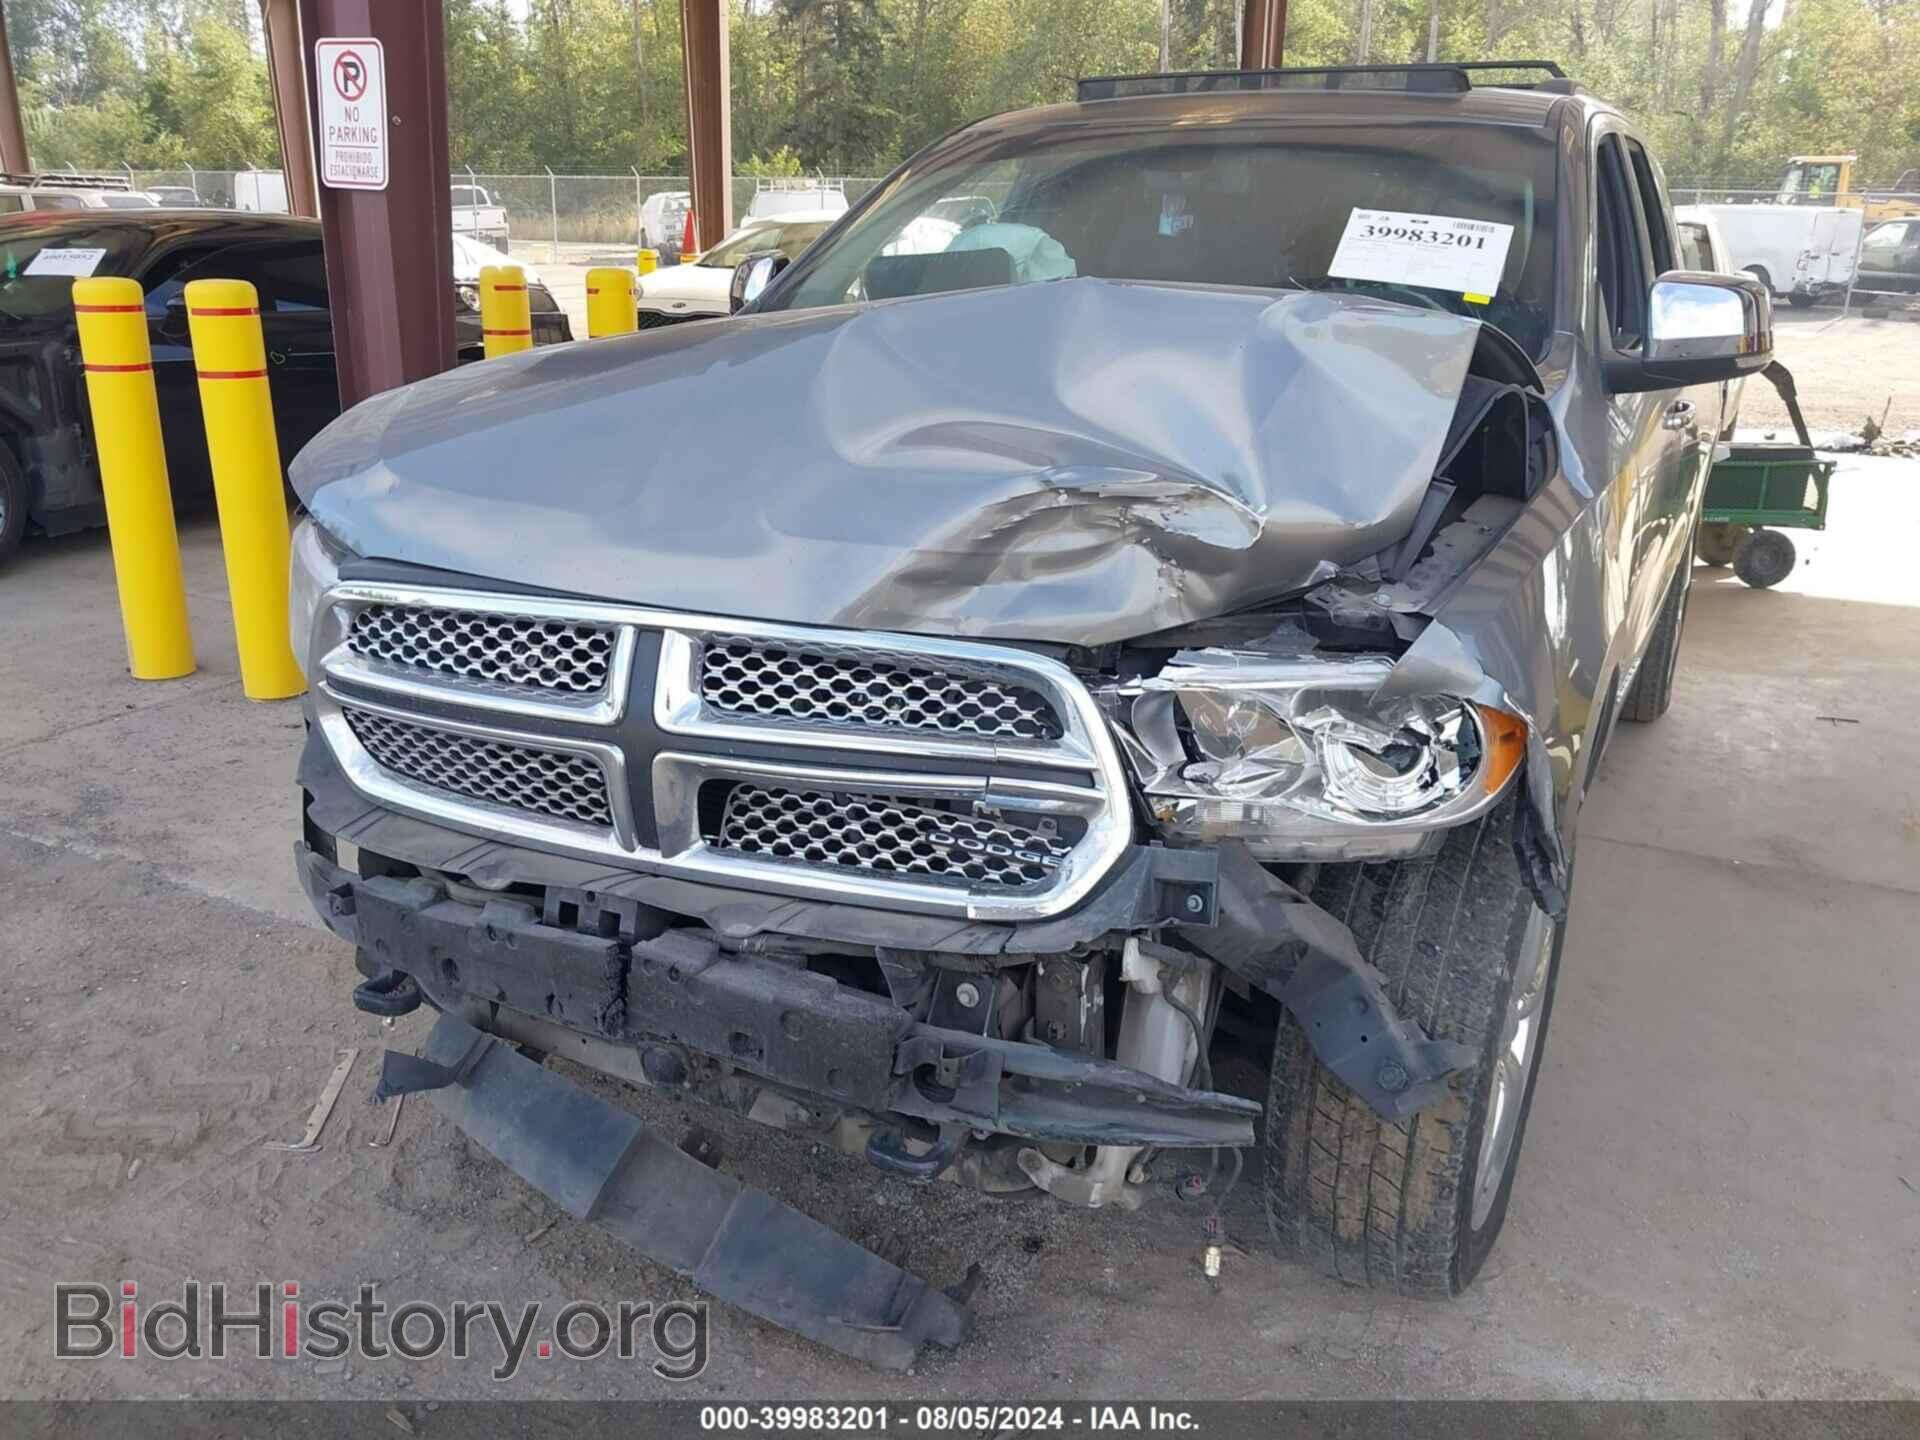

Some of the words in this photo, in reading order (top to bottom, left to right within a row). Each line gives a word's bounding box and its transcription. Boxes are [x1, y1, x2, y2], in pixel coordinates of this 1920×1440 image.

[344, 105, 360, 122] NO
[328, 126, 378, 144] PARKING
[1360, 224, 1486, 250] 39983201
[928, 832, 1064, 867] DODGE
